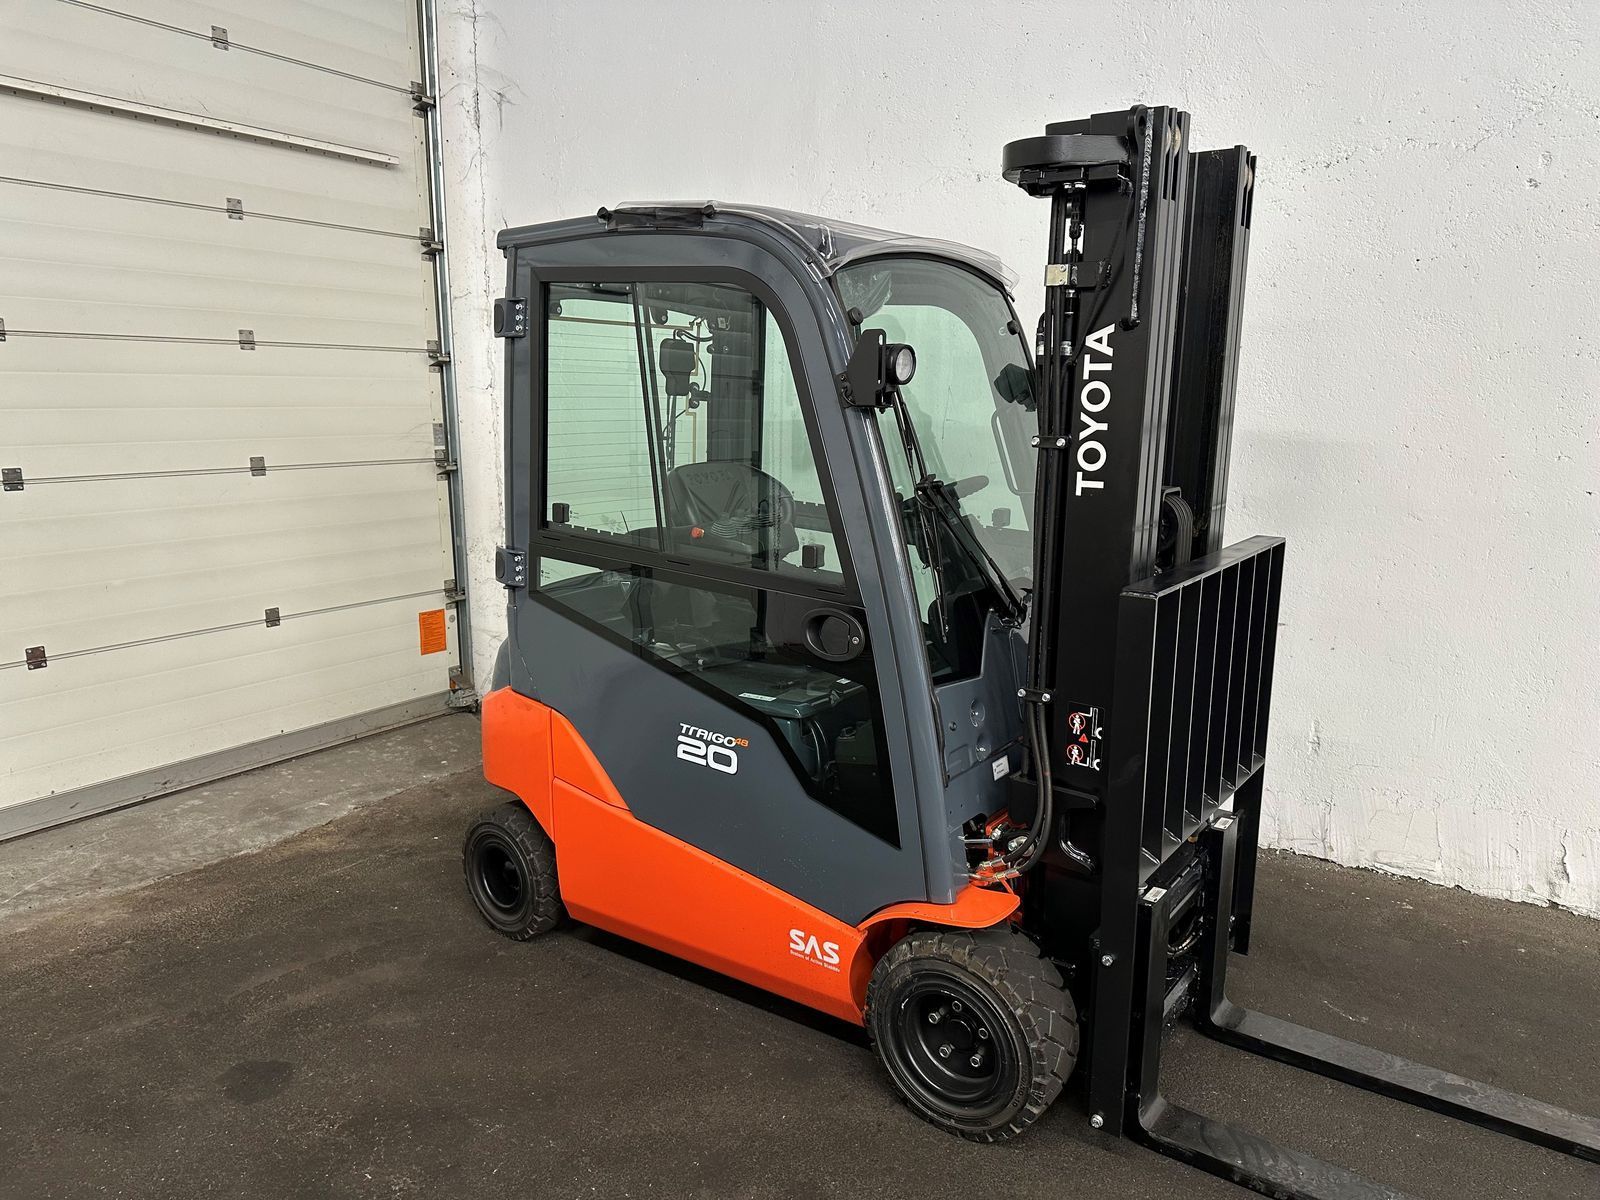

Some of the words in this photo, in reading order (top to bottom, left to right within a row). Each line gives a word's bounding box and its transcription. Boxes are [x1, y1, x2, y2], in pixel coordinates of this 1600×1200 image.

[1075, 323, 1116, 496] TOYOTA
[676, 735, 738, 775] 20
[789, 928, 840, 964] SAS
